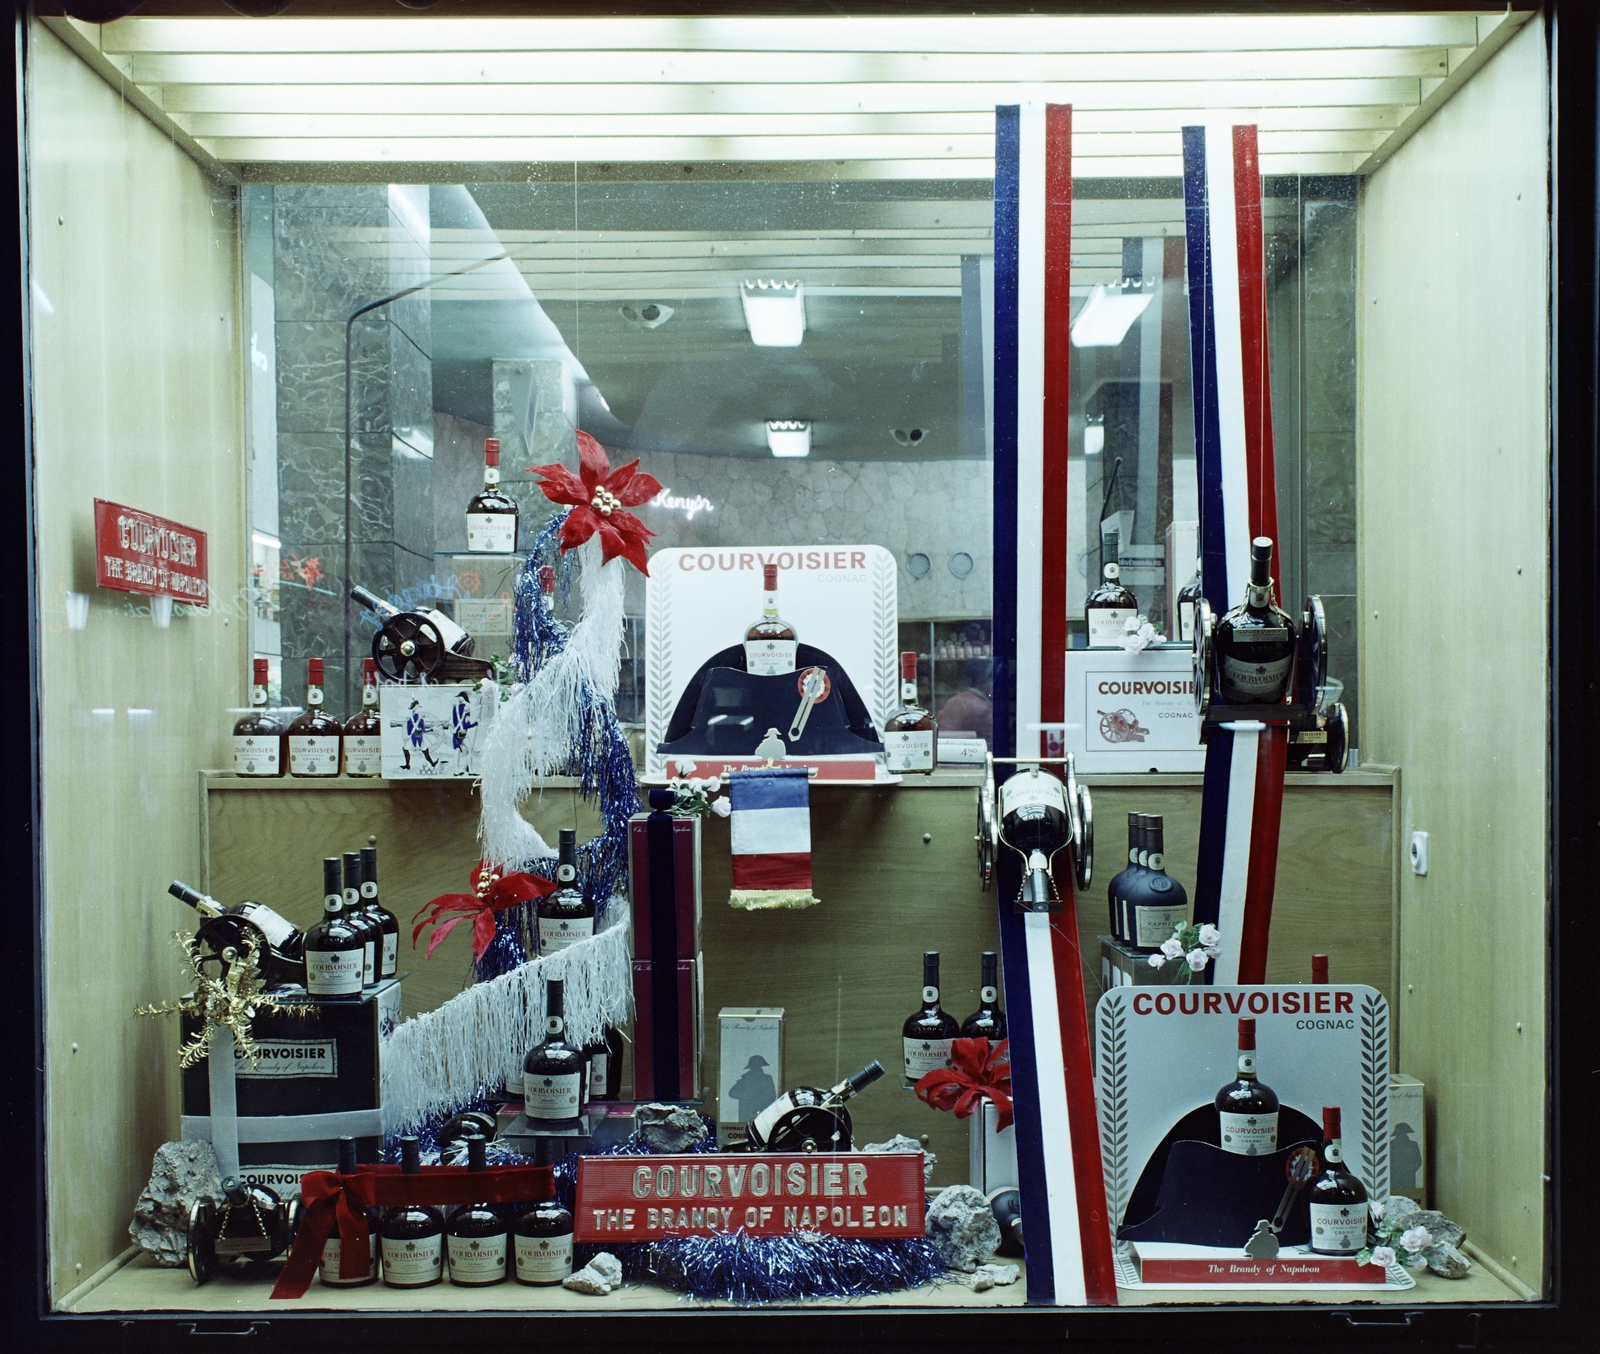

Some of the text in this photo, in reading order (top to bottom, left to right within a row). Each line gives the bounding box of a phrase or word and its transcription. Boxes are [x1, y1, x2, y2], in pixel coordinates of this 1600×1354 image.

[117, 515, 197, 567] COURVOISIER
[679, 551, 866, 571] COURVOISIER
[104, 555, 207, 598] THE BRANDY OF NAPOLEON
[817, 574, 867, 583] COGNAC
[1233, 672, 1285, 682] COURVOISIER
[312, 963, 358, 971] COURVOISIER
[1133, 992, 1354, 1015] COURVOISIER
[1296, 1019, 1355, 1030] COGNAC
[527, 1086, 572, 1094] COURVOISIER
[1225, 1126, 1275, 1134] COURVOISIER
[632, 1163, 868, 1199] COURVOISIER
[592, 1205, 908, 1230] THE BRANDY OF NAPOLEON
[1316, 1217, 1366, 1225] COURVOISIER
[387, 1249, 435, 1259] COURVOISIER
[452, 1249, 499, 1258] COURVOISIER
[521, 1248, 567, 1258] COURVOISIER
[1208, 1264, 1320, 1276] The Brandy of Napoleon
